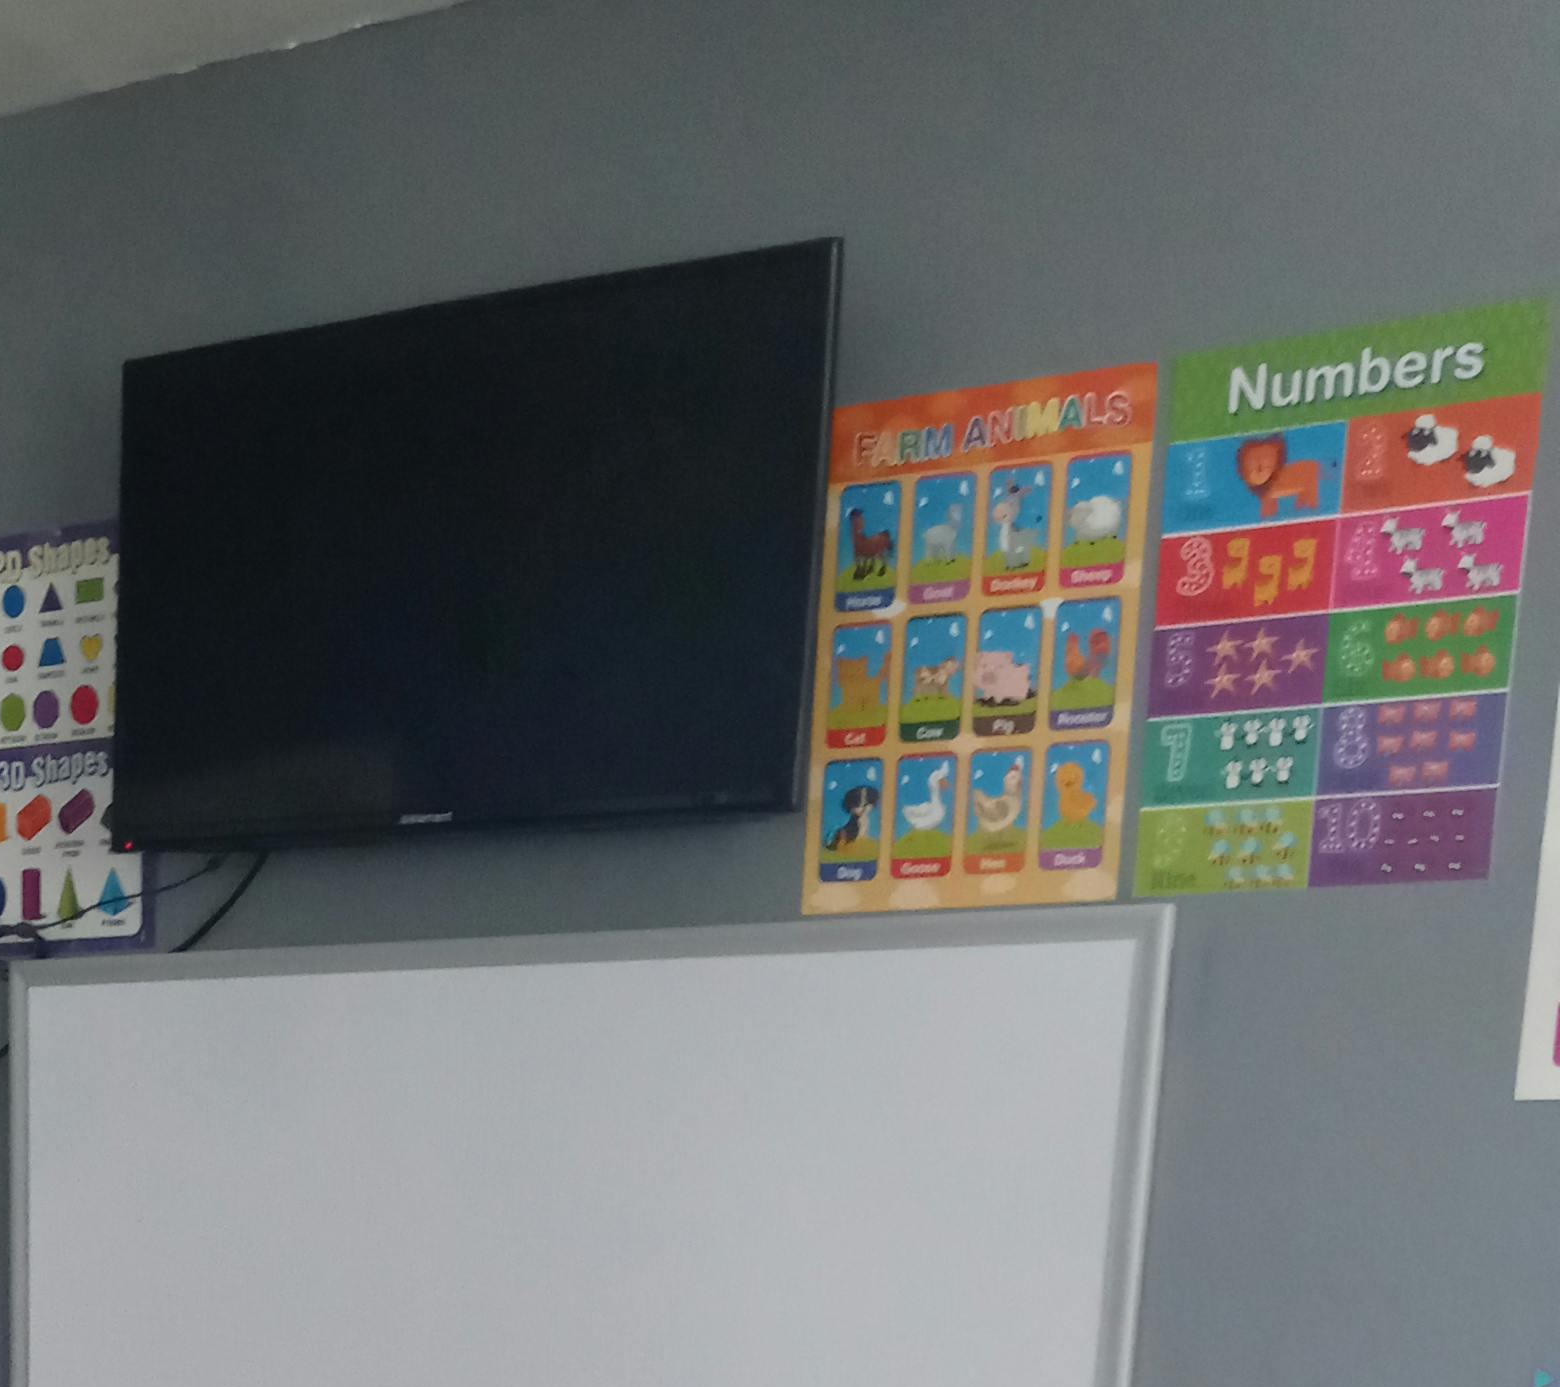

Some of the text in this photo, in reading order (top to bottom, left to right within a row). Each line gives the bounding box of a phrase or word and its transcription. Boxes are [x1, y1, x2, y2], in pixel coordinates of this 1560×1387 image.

[1228, 341, 1485, 415] Numbers
[851, 390, 1133, 468] FARM ANIMALS
[1354, 422, 1385, 482] 2
[27, 536, 111, 578] Shapes
[1176, 535, 1215, 597] 3
[1164, 631, 1194, 689] 5
[1339, 619, 1375, 678] 6
[843, 732, 867, 747] Cat
[915, 726, 944, 740] Cow
[991, 718, 1016, 735] Pig
[1160, 723, 1192, 783] 7
[1334, 704, 1370, 770] 8
[30, 751, 109, 788] Shapes
[1318, 797, 1382, 854] 10
